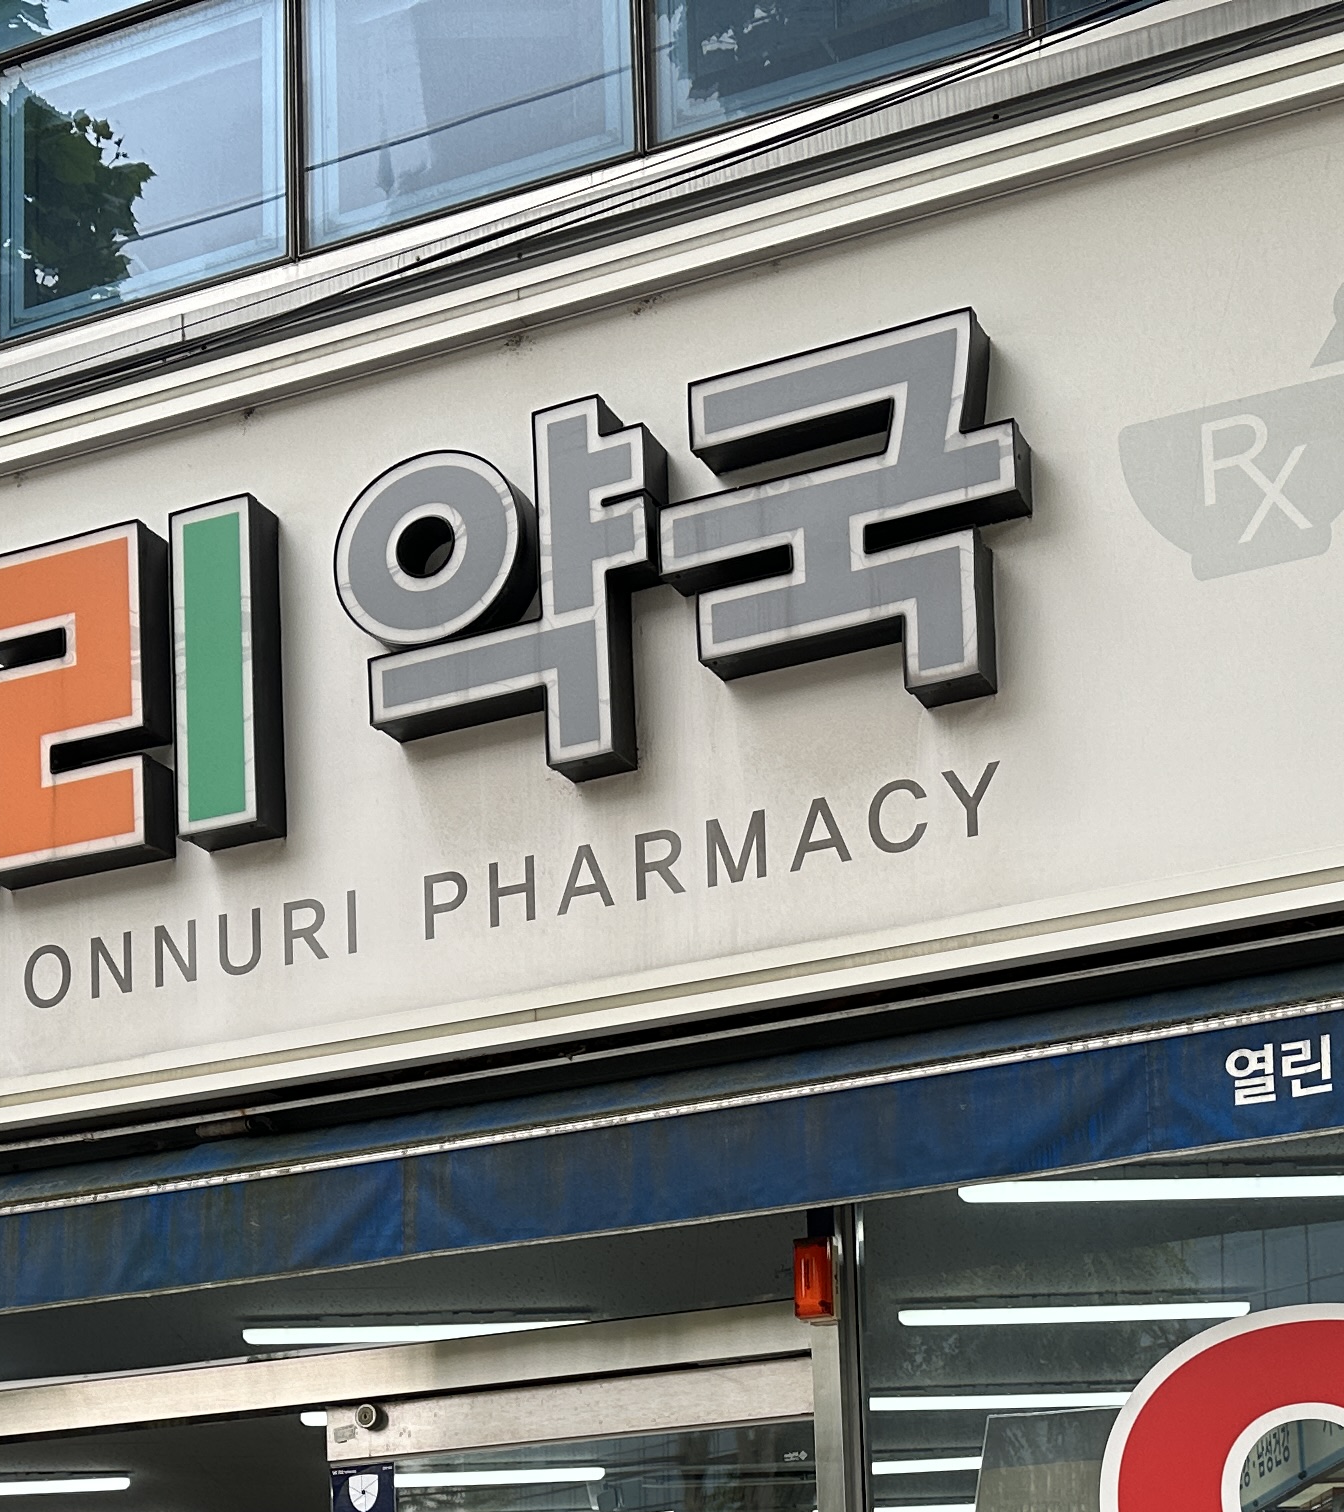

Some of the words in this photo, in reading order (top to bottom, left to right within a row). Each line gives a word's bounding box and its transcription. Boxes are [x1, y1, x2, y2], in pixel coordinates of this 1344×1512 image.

[333, 307, 1032, 782] 약국
[24, 889, 362, 1010] ONNURI
[423, 760, 1001, 941] PHARMACY
[1225, 1034, 1334, 1107] 열린
